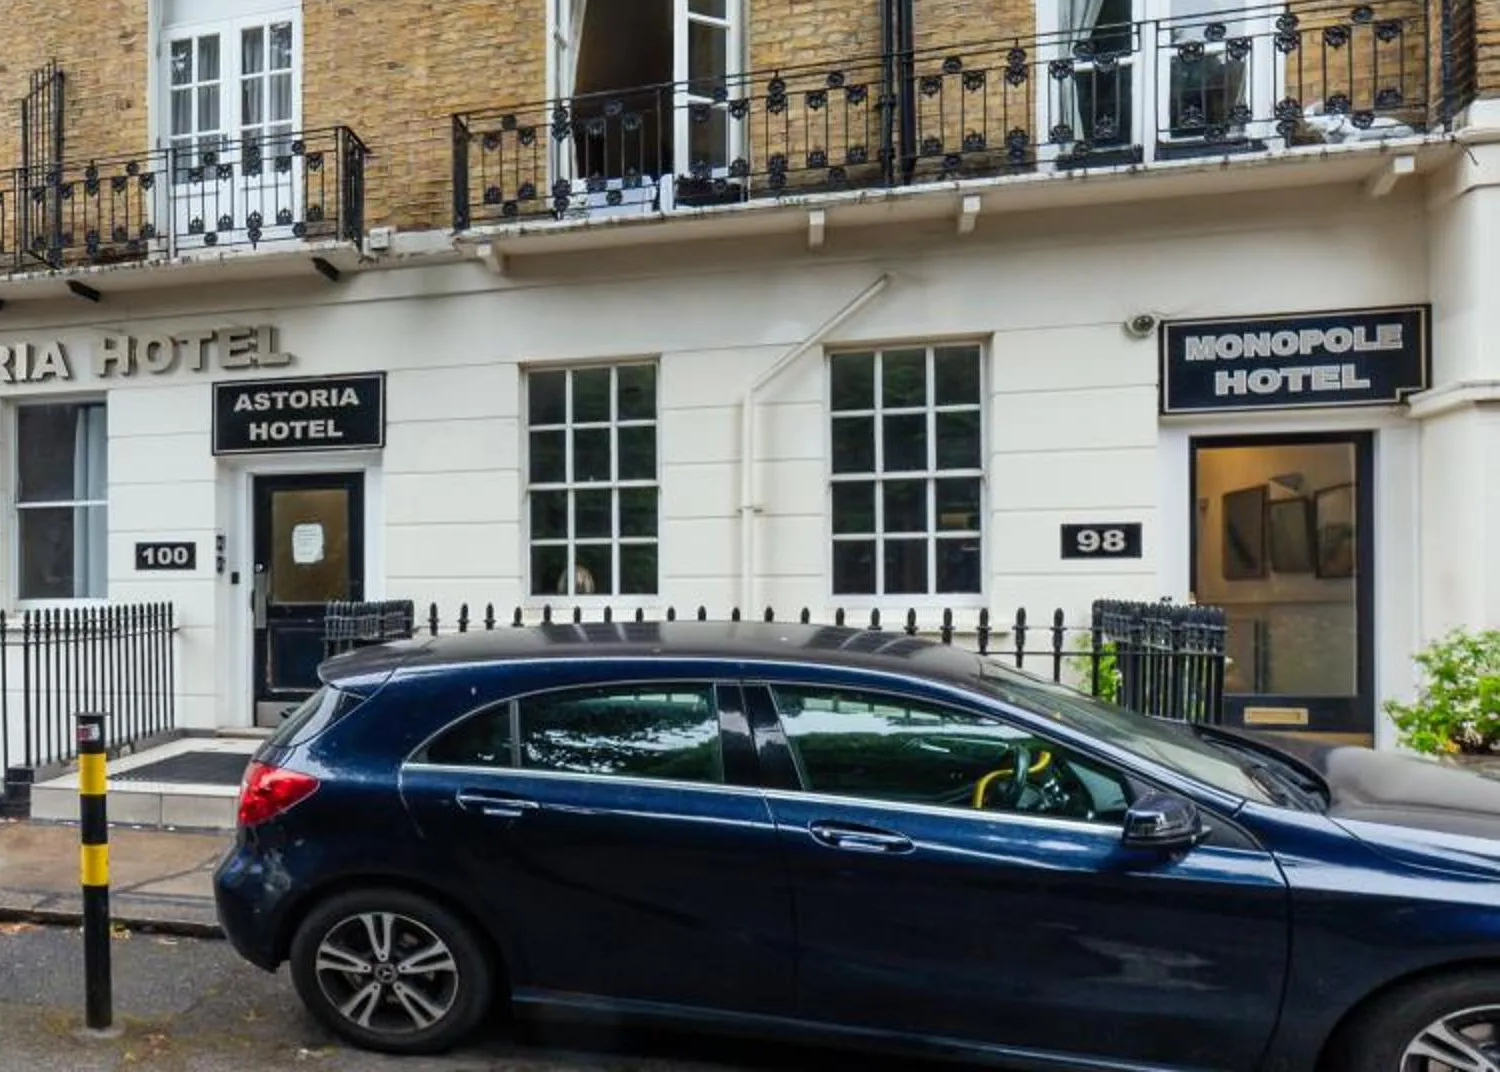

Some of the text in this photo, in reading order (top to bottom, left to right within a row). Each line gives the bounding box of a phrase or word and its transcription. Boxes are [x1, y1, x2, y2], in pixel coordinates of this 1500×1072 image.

[95, 325, 296, 376] HOTEL
[1185, 324, 1403, 361] MONOPOLE
[1215, 364, 1370, 396] HOTEL
[234, 387, 359, 412] ASTORIA
[249, 419, 343, 441] HOTEL
[1076, 529, 1126, 552] 98
[142, 546, 189, 566] 100
